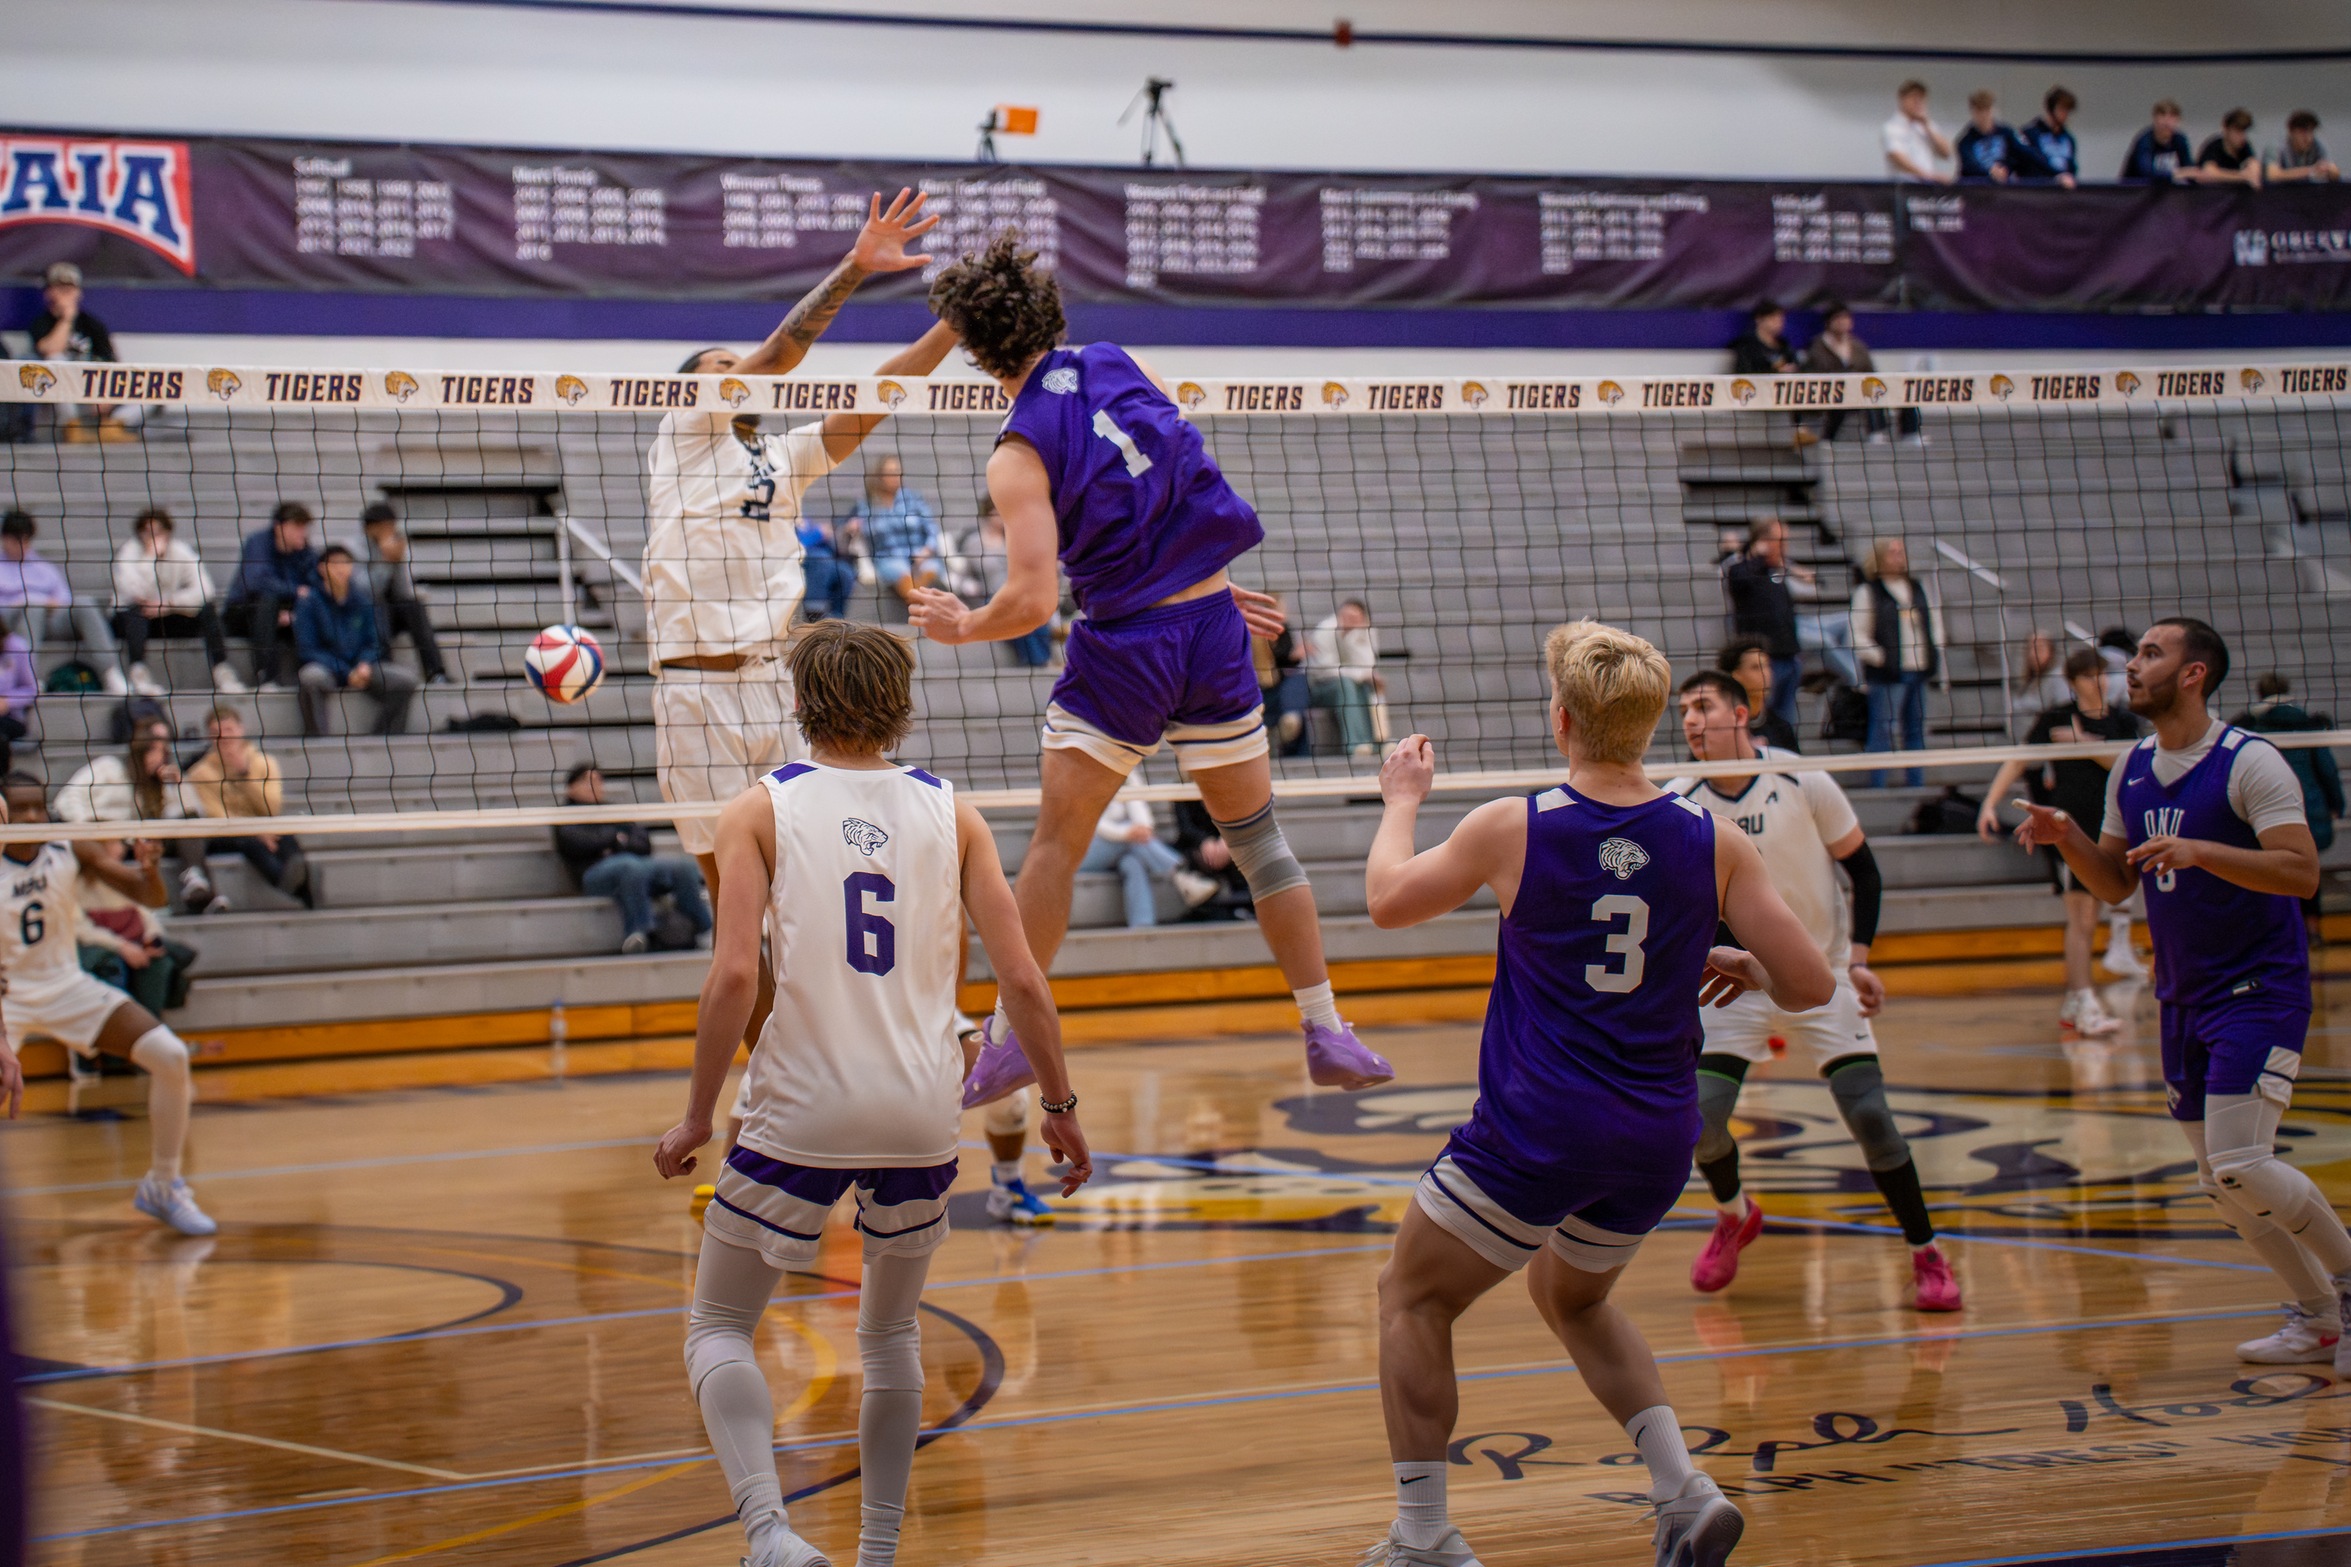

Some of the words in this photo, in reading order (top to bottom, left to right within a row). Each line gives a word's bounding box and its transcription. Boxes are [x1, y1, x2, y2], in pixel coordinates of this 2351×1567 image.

[0, 142, 188, 256] AIA
[82, 369, 183, 399] TIGERS
[265, 373, 363, 402] TIGERS
[441, 376, 535, 404] TIGERS
[610, 380, 699, 407] TIGERS
[771, 382, 858, 410] TIGERS
[927, 384, 1009, 411] TIGERS
[1224, 385, 1303, 411] TIGERS
[1367, 384, 1443, 410] TIGERS
[1507, 384, 1581, 409] TIGERS
[1641, 383, 1714, 407] TIGERS
[1774, 380, 1846, 405] TIGERS
[1903, 378, 1974, 402] TIGERS
[2031, 376, 2100, 400] TIGERS
[2157, 372, 2225, 397] TIGERS
[2281, 368, 2347, 393] TIGERS
[1092, 407, 1153, 479] 1
[1731, 812, 1764, 836] BU
[2143, 806, 2185, 838] ONU
[20, 901, 44, 946] 6
[843, 871, 896, 977] 6
[1585, 894, 1650, 993] 3
